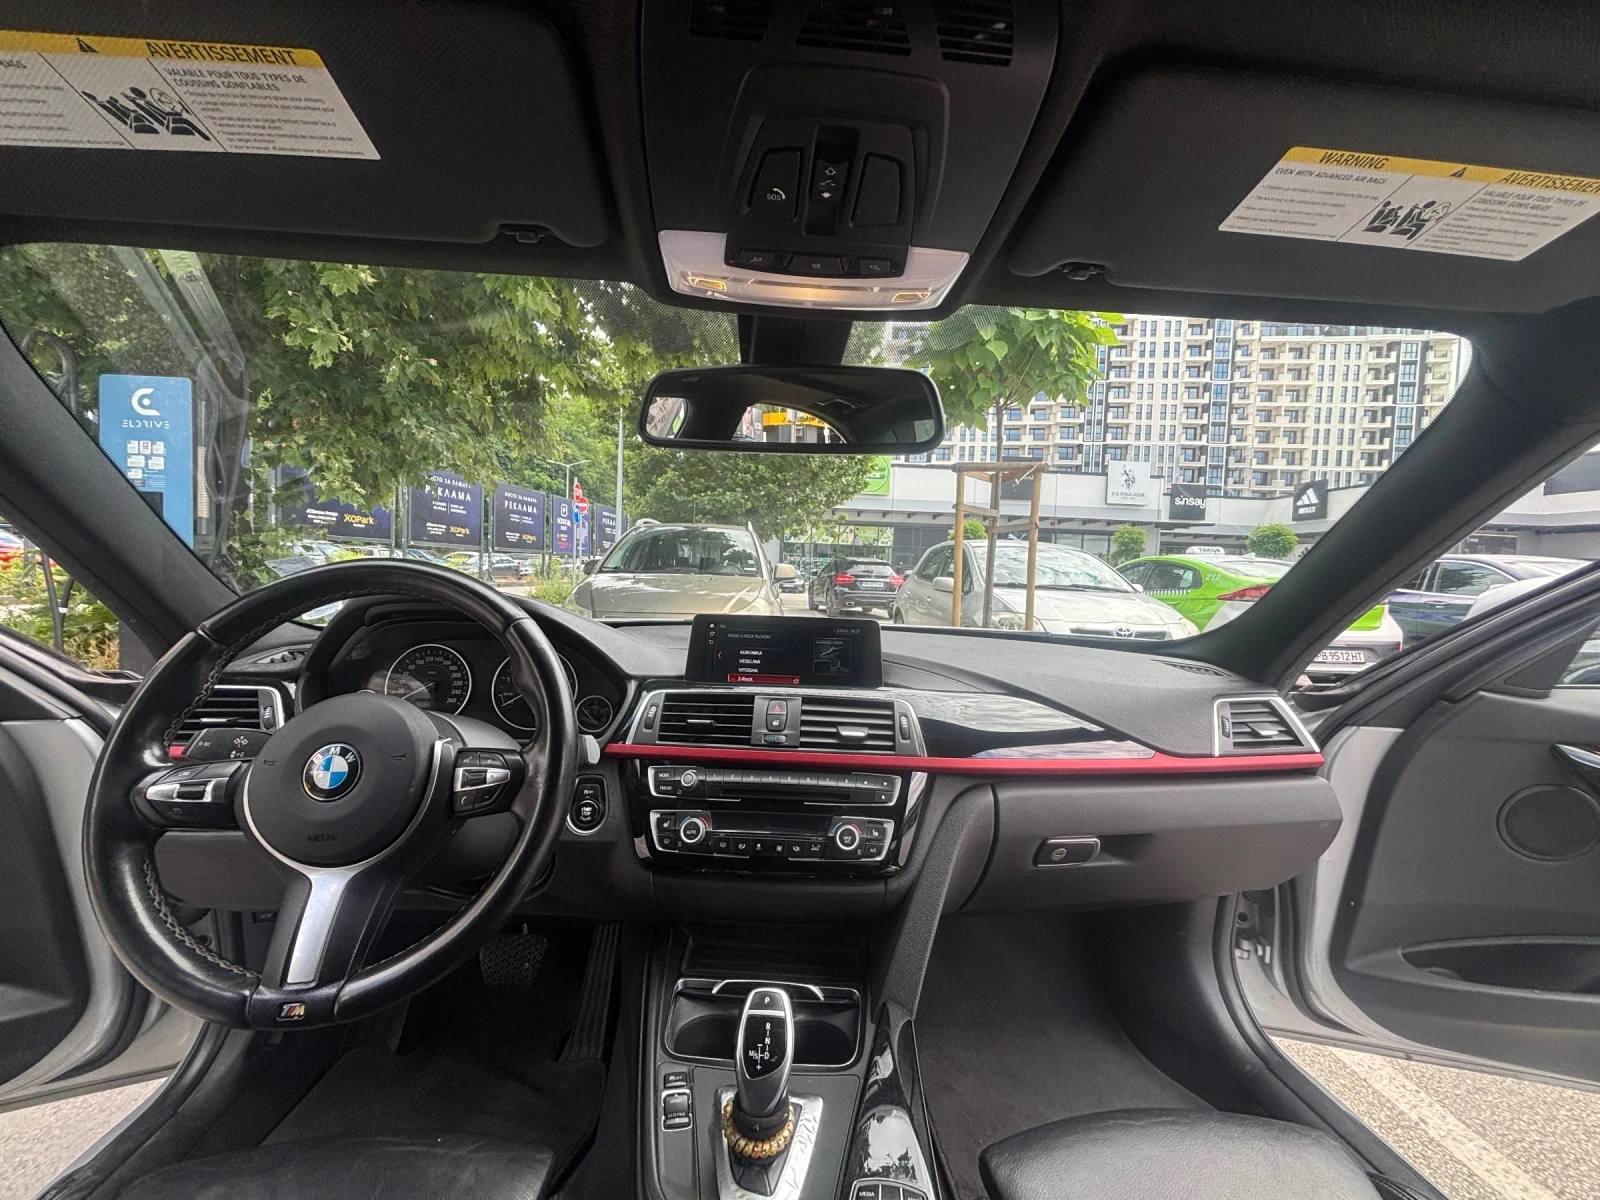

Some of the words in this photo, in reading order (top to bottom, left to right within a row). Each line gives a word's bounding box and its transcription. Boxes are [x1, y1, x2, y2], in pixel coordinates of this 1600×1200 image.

[145, 41, 297, 65] AVERTISSEMENT
[164, 68, 206, 78] VALABLE
[207, 70, 233, 79] POUR
[233, 71, 260, 80] TOUS
[262, 73, 291, 83] TYPES
[292, 75, 306, 83] DE
[174, 79, 220, 88] COUSSINS
[220, 81, 280, 91] GONFLABLES
[1320, 152, 1389, 169] WARNING
[1295, 169, 1314, 177] WITH
[1315, 171, 1352, 181] ADVANCED
[1352, 174, 1365, 182] AIR
[1366, 176, 1387, 185] BAGS
[766, 193, 781, 201] SOS
[122, 419, 170, 429] ELDRIVE
[425, 484, 471, 502] РКЛАМА
[504, 500, 537, 514] РЕКЛАМА
[1174, 494, 1206, 509] sinsay
[1328, 651, 1351, 661] 9512
[1351, 652, 1363, 661] HT
[312, 746, 356, 764] BMW
[307, 833, 338, 843] AIRBAG
[764, 996, 770, 1004] P
[765, 1022, 771, 1030] R
[765, 1036, 770, 1045] N
[764, 1051, 770, 1060] D
